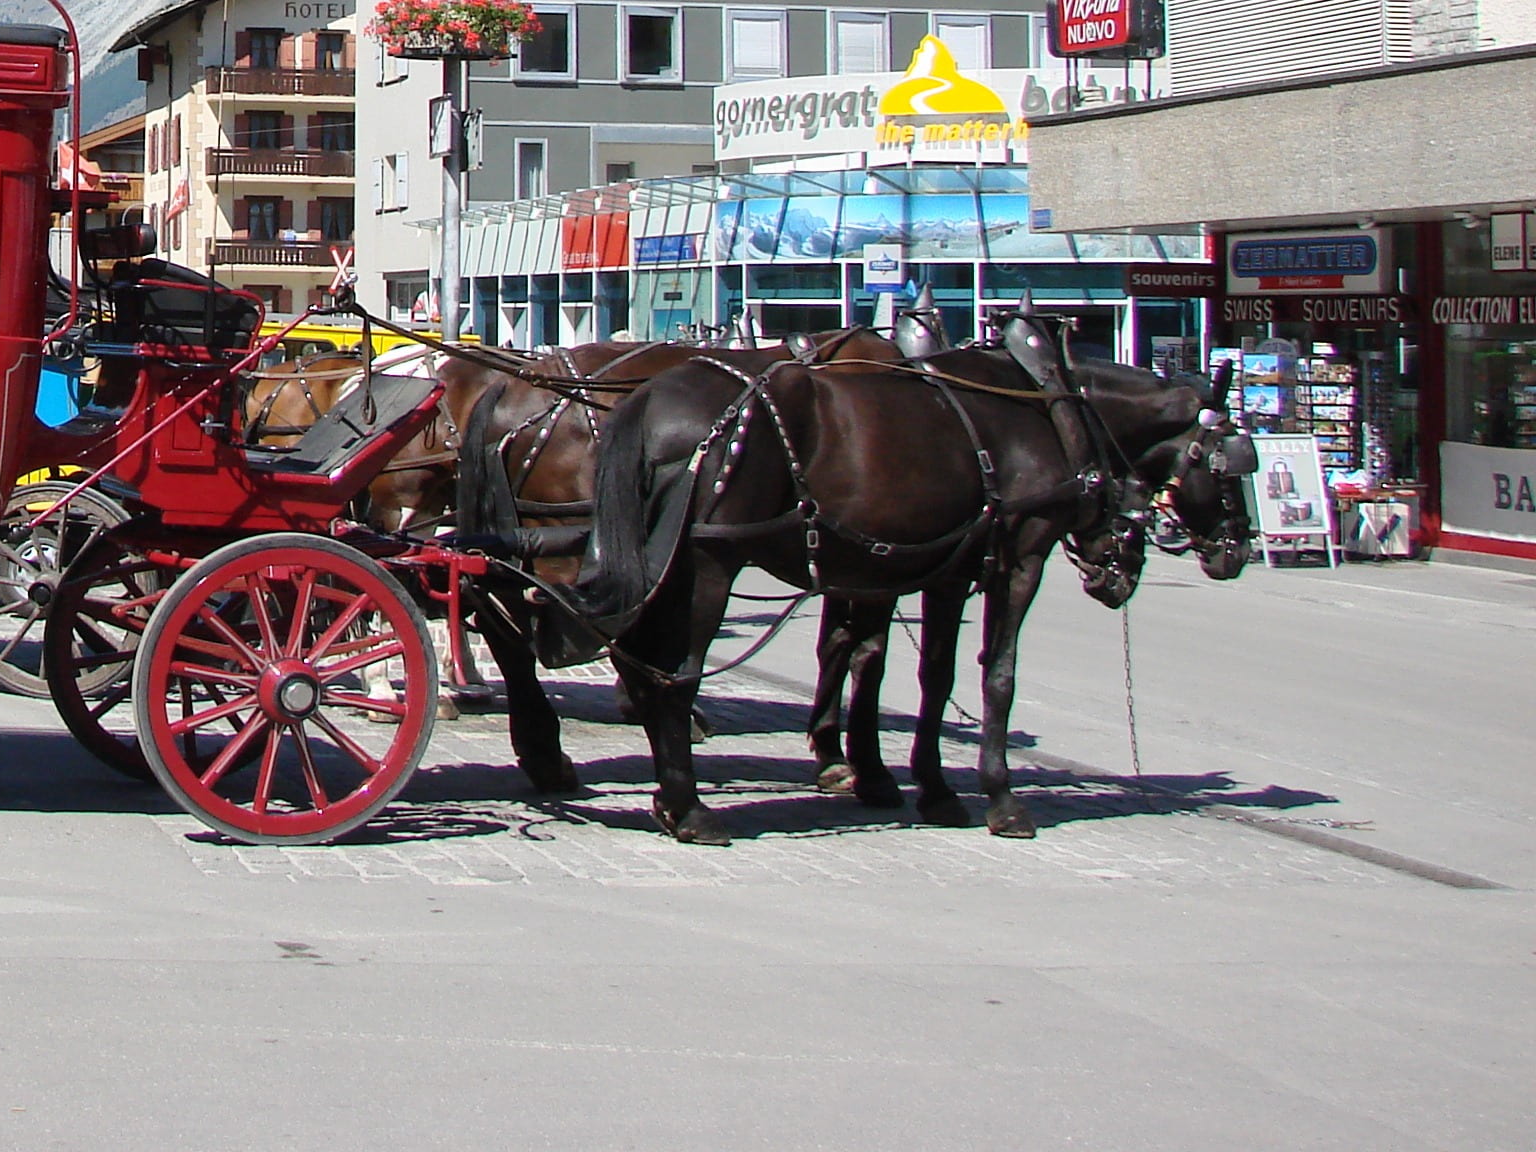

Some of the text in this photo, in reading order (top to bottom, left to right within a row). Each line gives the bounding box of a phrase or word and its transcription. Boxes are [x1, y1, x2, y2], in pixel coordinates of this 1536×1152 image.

[715, 83, 878, 140] gornergrat
[874, 117, 915, 145] the
[1236, 242, 1368, 271] ZERMATTER
[1131, 272, 1216, 287] souvenirs
[1223, 296, 1401, 322] SWISS SOUVENIRS
[1431, 296, 1512, 325] COLLECTION
[1492, 472, 1536, 513] BA
